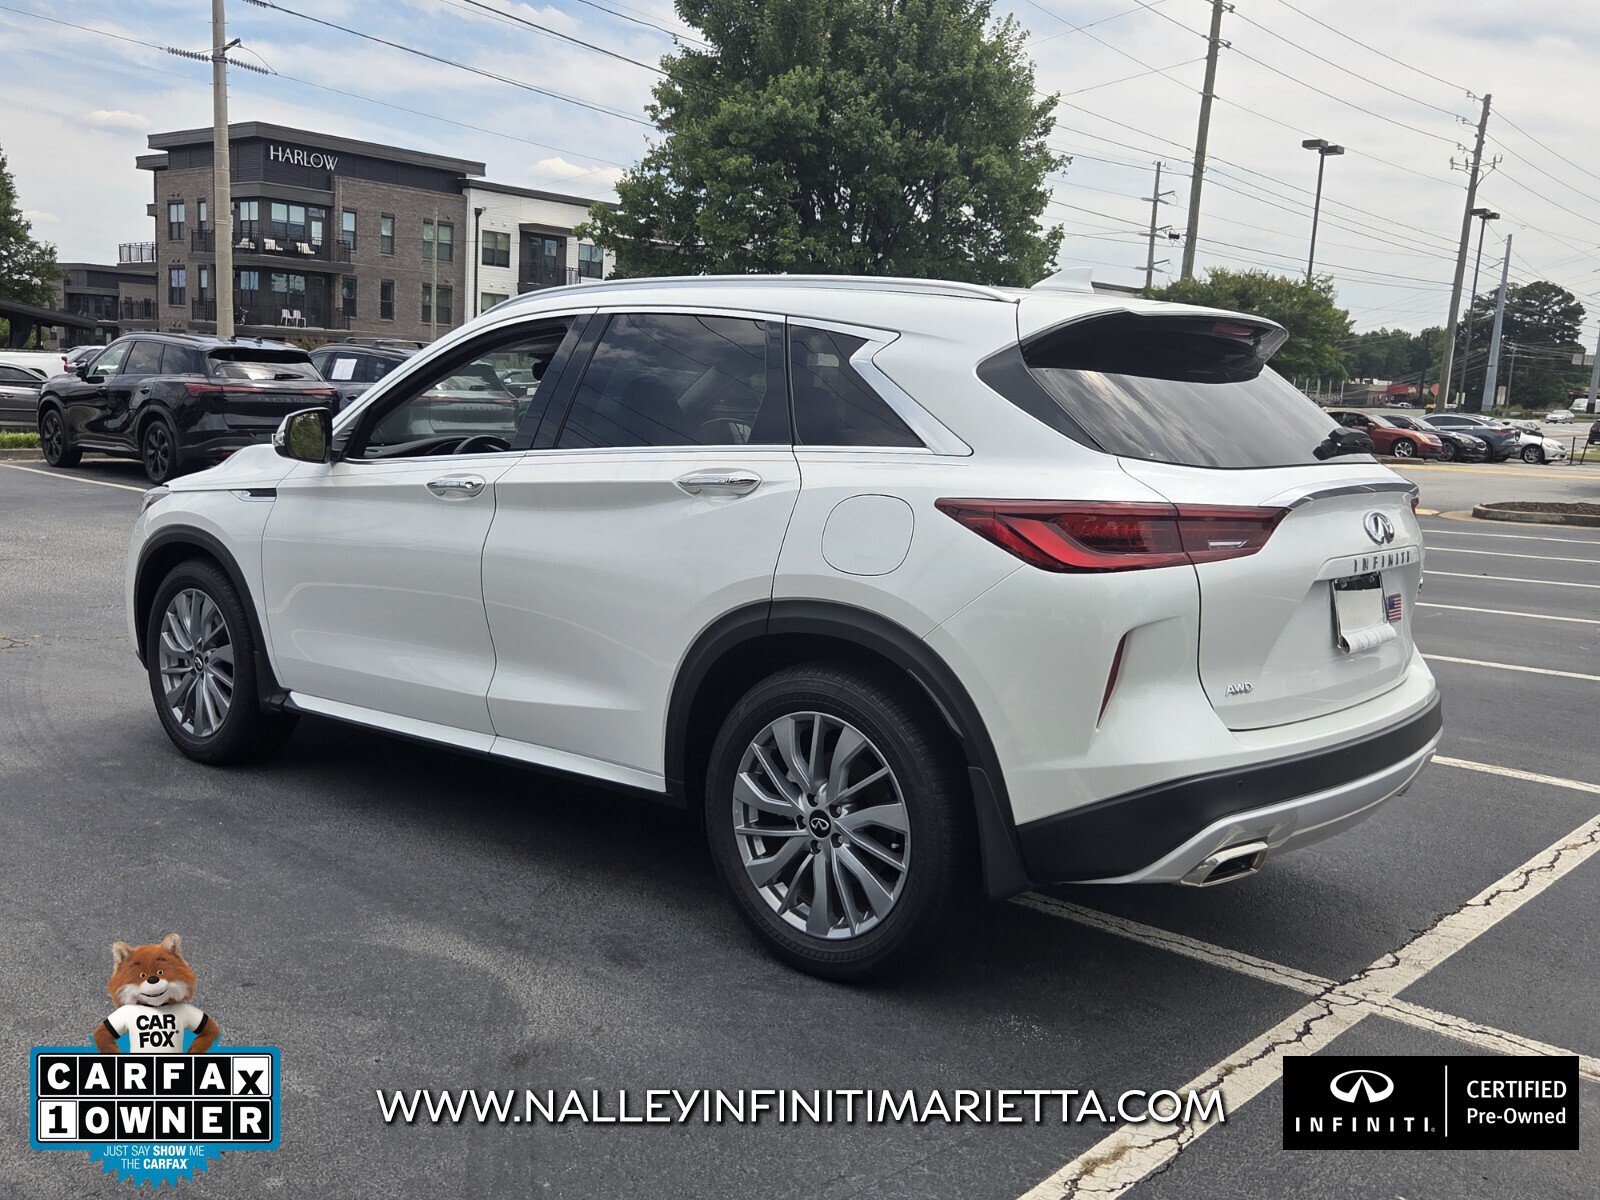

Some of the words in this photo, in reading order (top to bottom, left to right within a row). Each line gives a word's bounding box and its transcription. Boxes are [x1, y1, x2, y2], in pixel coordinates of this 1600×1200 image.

[269, 144, 339, 171] HARLOW
[1353, 550, 1410, 573] INFINITI
[1225, 682, 1254, 697] AWD
